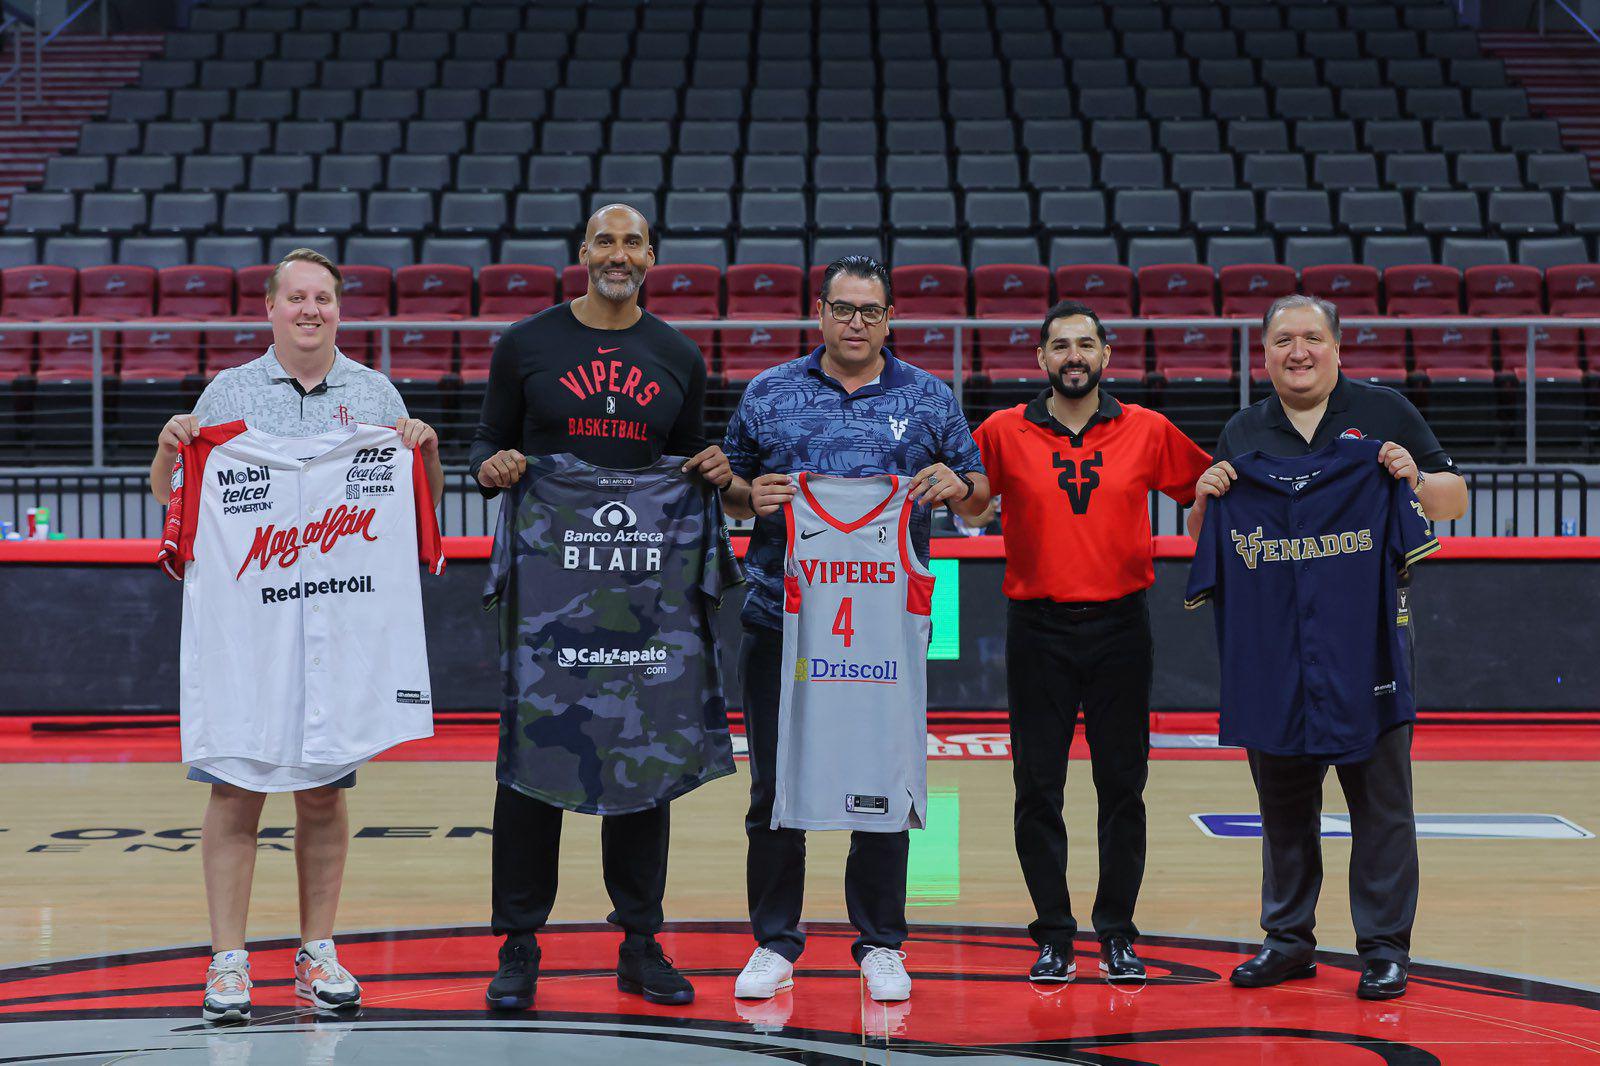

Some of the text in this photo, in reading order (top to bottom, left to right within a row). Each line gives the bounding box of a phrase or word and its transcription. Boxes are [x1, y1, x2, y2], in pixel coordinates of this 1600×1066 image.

[559, 359, 661, 406] VIPERS
[568, 417, 648, 441] BASKETBALL
[217, 465, 270, 486] Mobil
[222, 483, 271, 503] telcel
[362, 485, 395, 493] HERSA
[236, 504, 378, 581] Mazatlán
[563, 530, 664, 542] Banco Azteca
[1230, 526, 1373, 569] VENADOS
[563, 546, 661, 571] BLAIR
[798, 559, 896, 586] VIPERS
[831, 596, 855, 648] 4
[577, 646, 667, 666] Calzzapato
[810, 658, 898, 680] Driscoll
